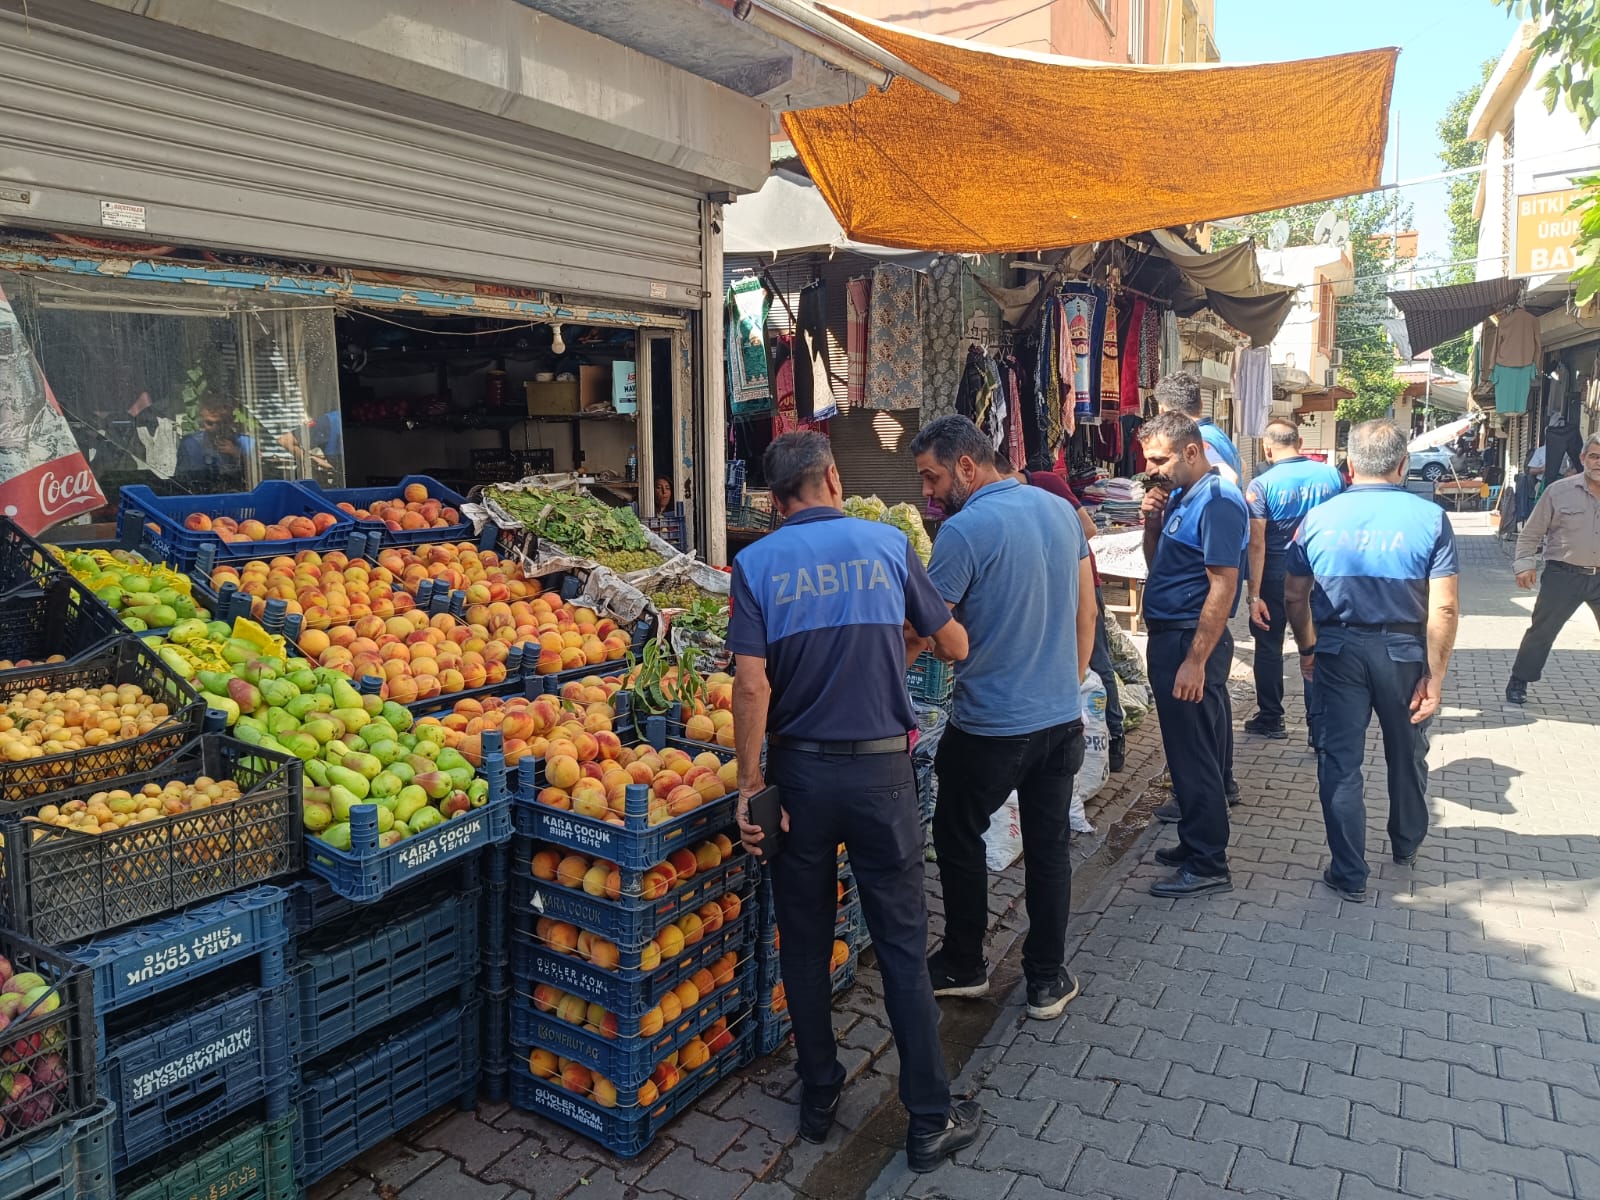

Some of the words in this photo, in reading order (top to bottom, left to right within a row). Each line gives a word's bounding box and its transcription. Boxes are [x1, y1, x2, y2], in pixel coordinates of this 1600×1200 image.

[1323, 528, 1406, 552] ZABITA
[772, 559, 891, 606] ZABITA
[542, 815, 572, 832] KARA
[399, 839, 437, 863] KARA
[441, 834, 470, 853] 15/16
[143, 944, 187, 966] 15/16
[194, 933, 242, 960] KARA
[227, 1026, 251, 1043] HAL
[214, 1034, 251, 1062] AYDIN
[133, 1057, 184, 1086] ADANA
